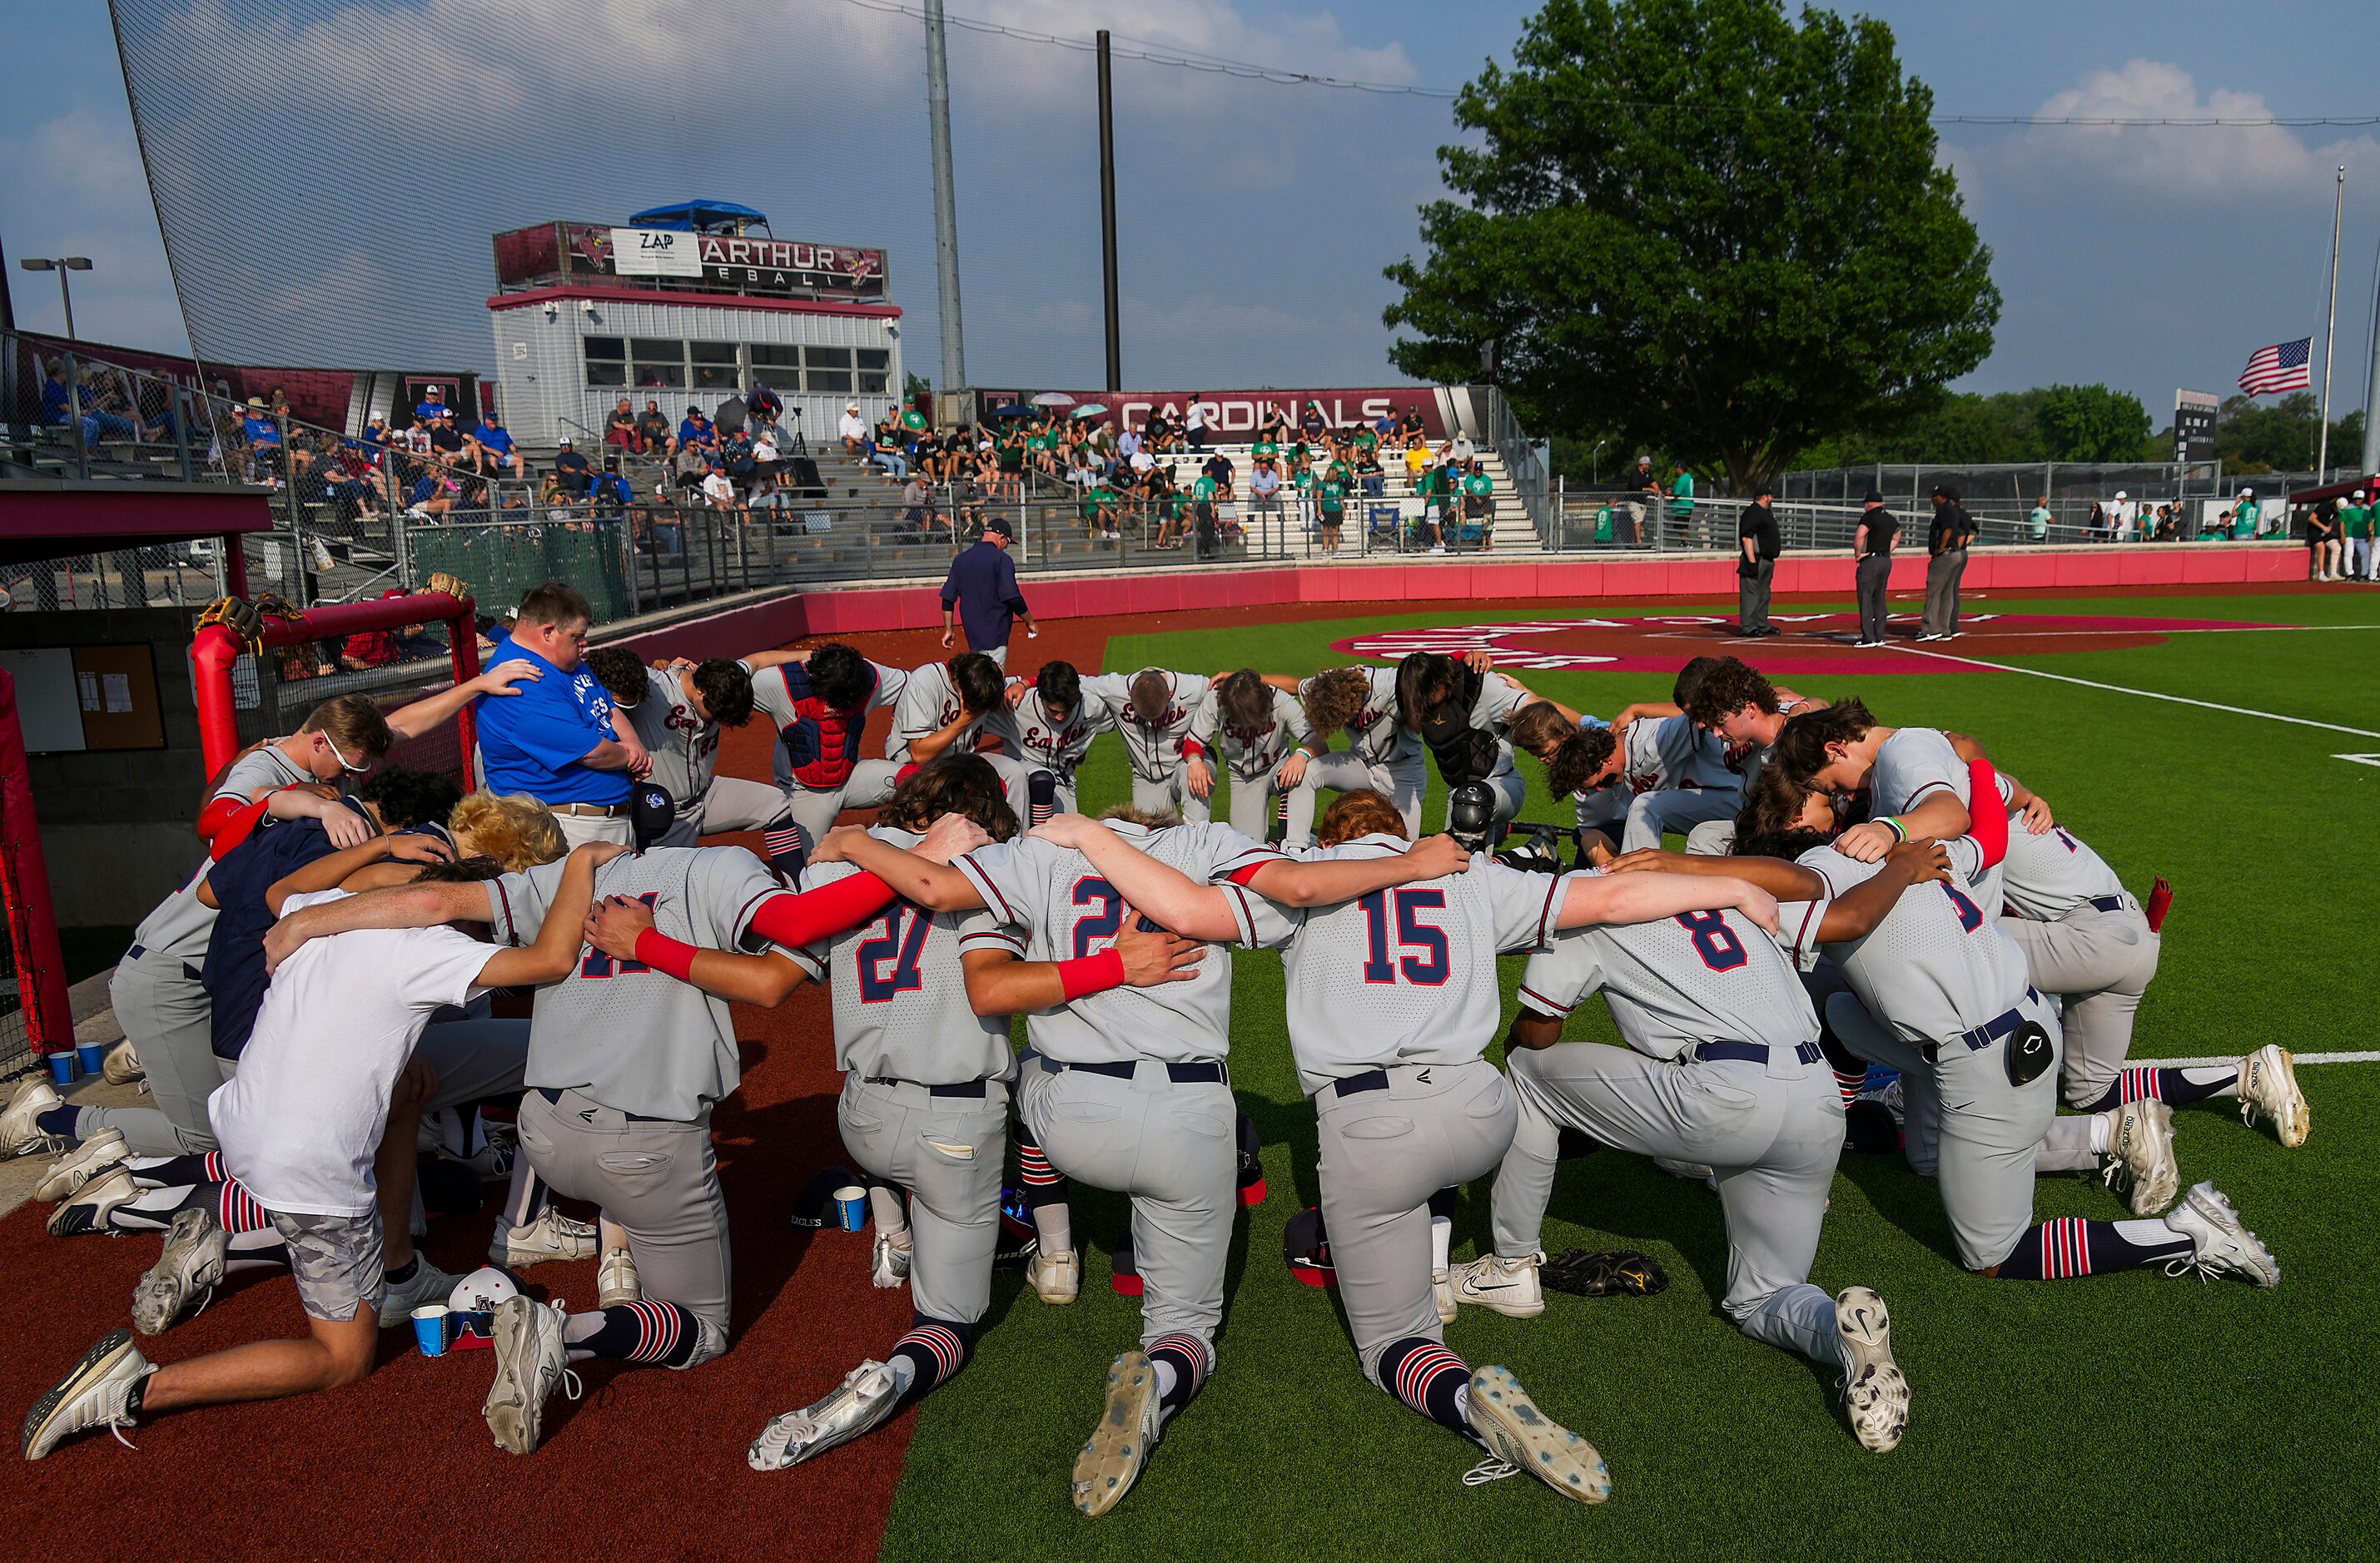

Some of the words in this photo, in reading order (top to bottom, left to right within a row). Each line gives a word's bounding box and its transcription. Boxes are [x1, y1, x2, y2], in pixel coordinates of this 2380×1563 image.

[639, 233, 673, 250] ZAP
[702, 239, 835, 270] ARTHUR
[1359, 888, 1453, 987] 15
[791, 1215, 822, 1227] EAGLES
